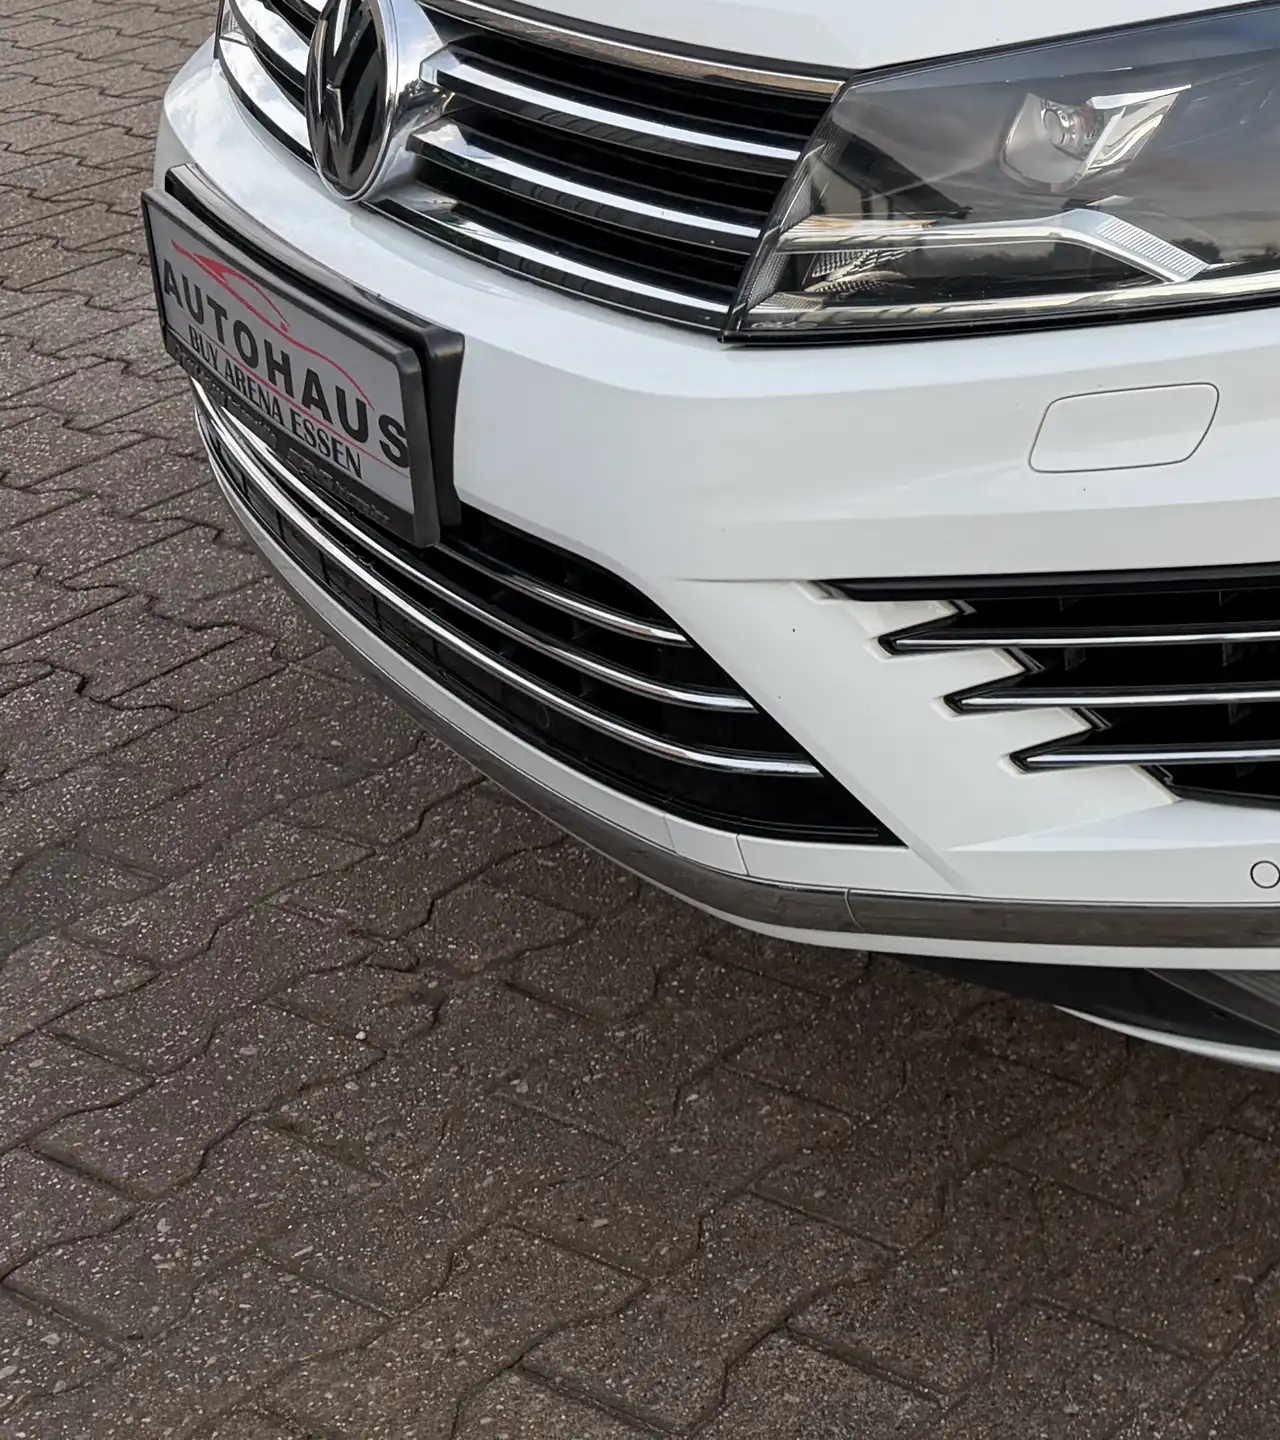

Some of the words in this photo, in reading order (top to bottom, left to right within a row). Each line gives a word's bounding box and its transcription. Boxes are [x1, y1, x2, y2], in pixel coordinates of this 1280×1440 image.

[162, 258, 410, 469] AUTOHAUS
[188, 324, 219, 373] BUY
[224, 358, 287, 428] ARENA
[288, 407, 363, 480] ESSEN
